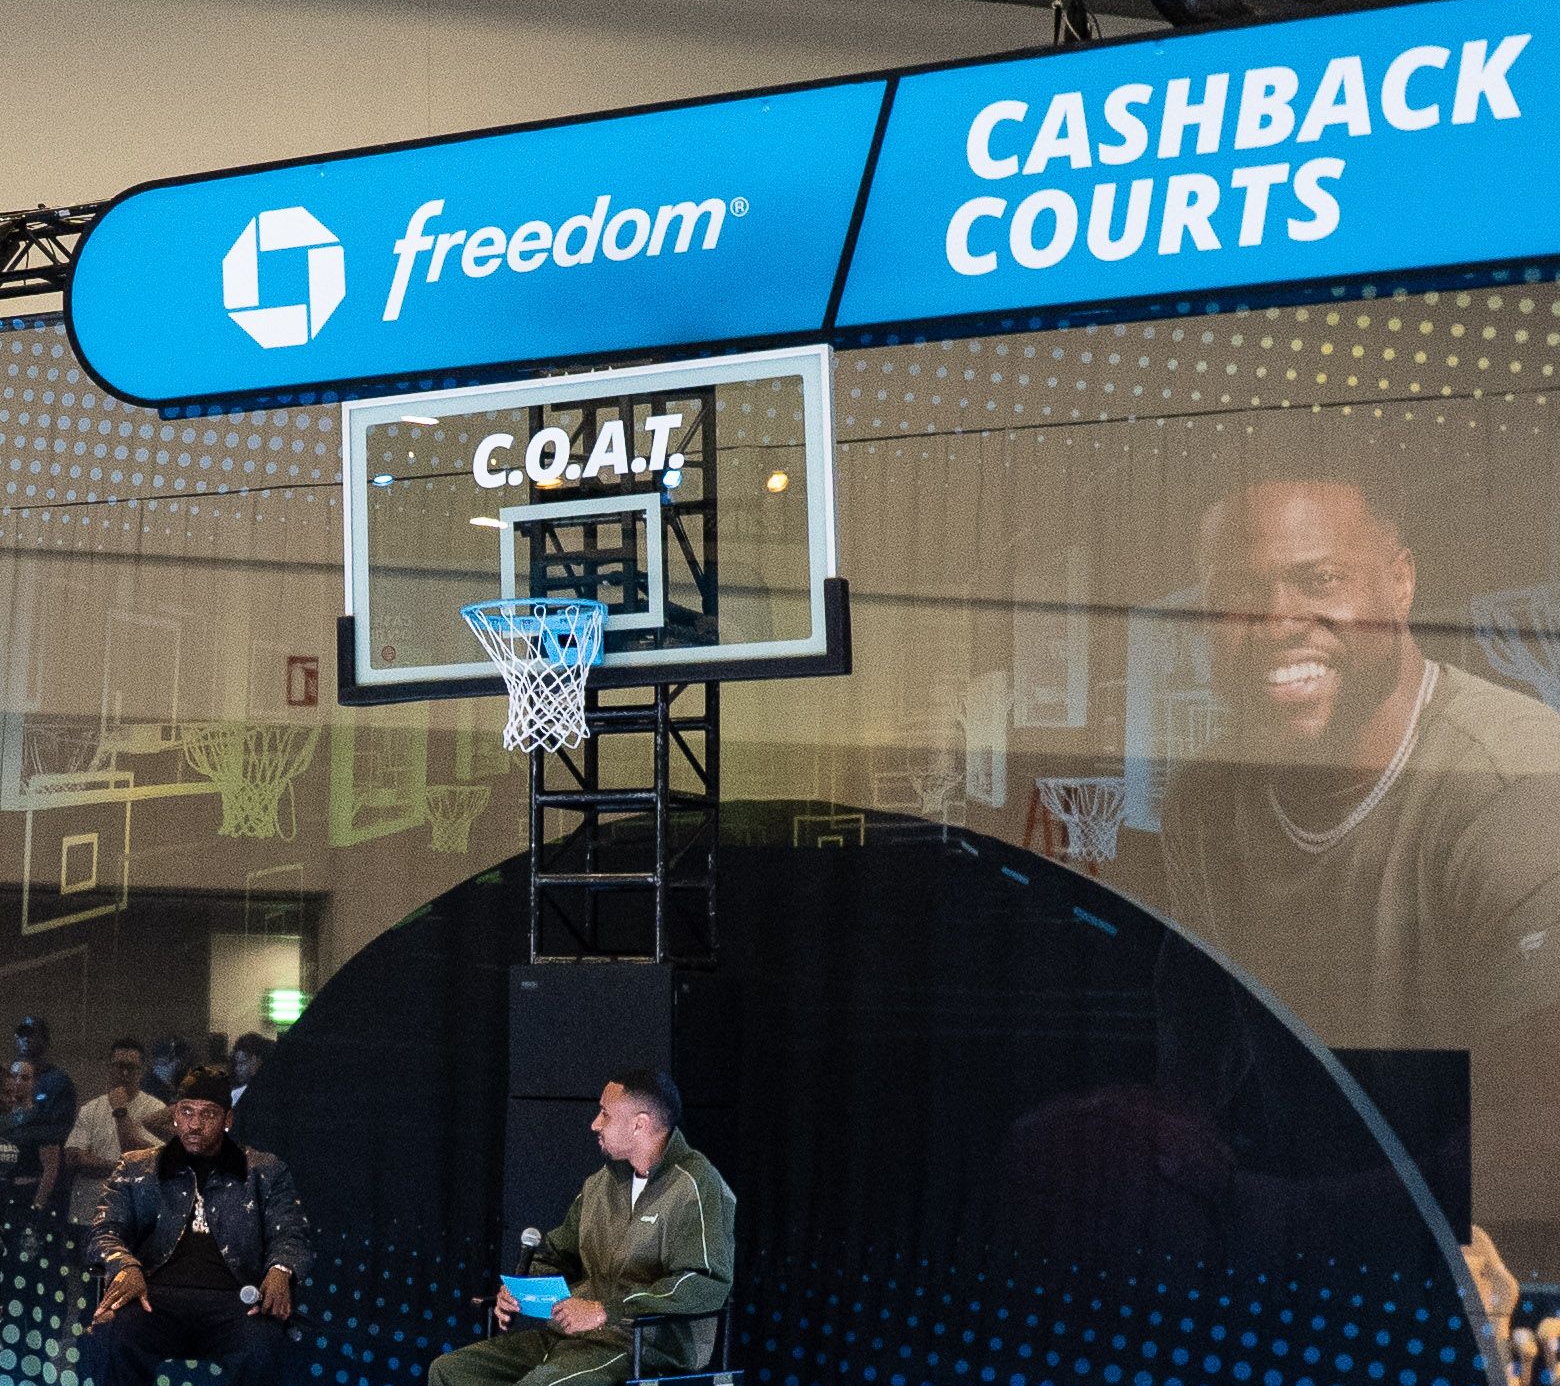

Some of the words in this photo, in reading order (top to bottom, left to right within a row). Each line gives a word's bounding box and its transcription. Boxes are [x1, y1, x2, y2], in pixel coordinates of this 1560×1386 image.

[966, 34, 1530, 180] CASHBACK
[383, 195, 727, 321] freedom
[944, 158, 1346, 276] COURTS
[473, 412, 685, 489] C.O.A.T.
